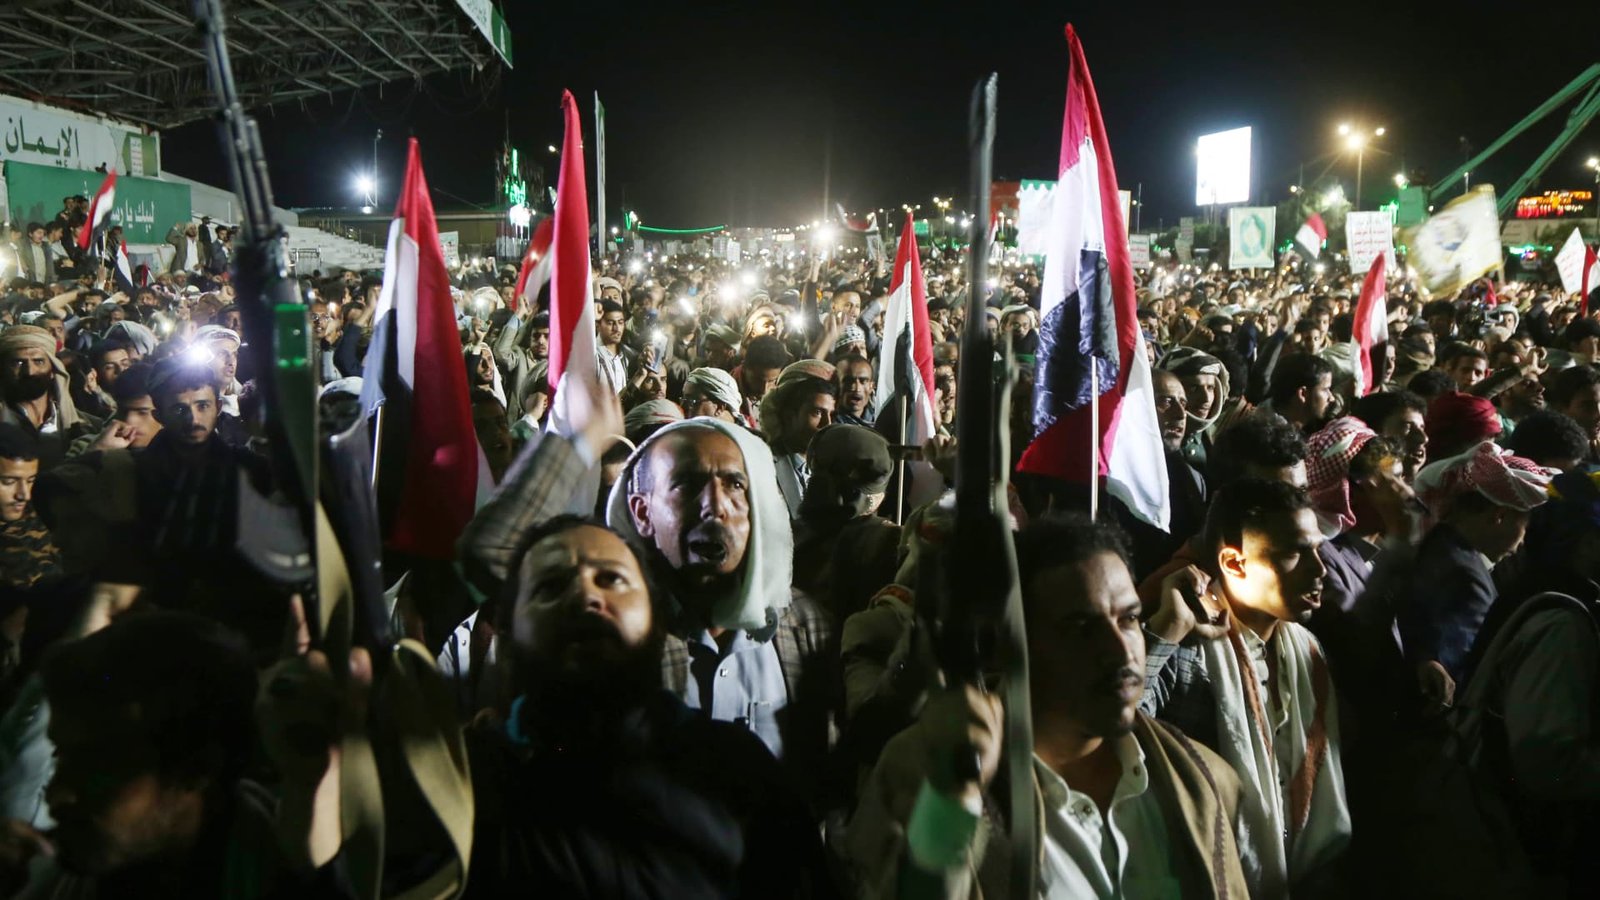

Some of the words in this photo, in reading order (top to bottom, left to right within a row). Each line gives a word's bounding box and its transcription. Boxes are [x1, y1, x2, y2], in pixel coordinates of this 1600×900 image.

[5, 114, 80, 168] الإيمان
[126, 199, 133, 229] يا
[135, 200, 154, 234] لبيك
